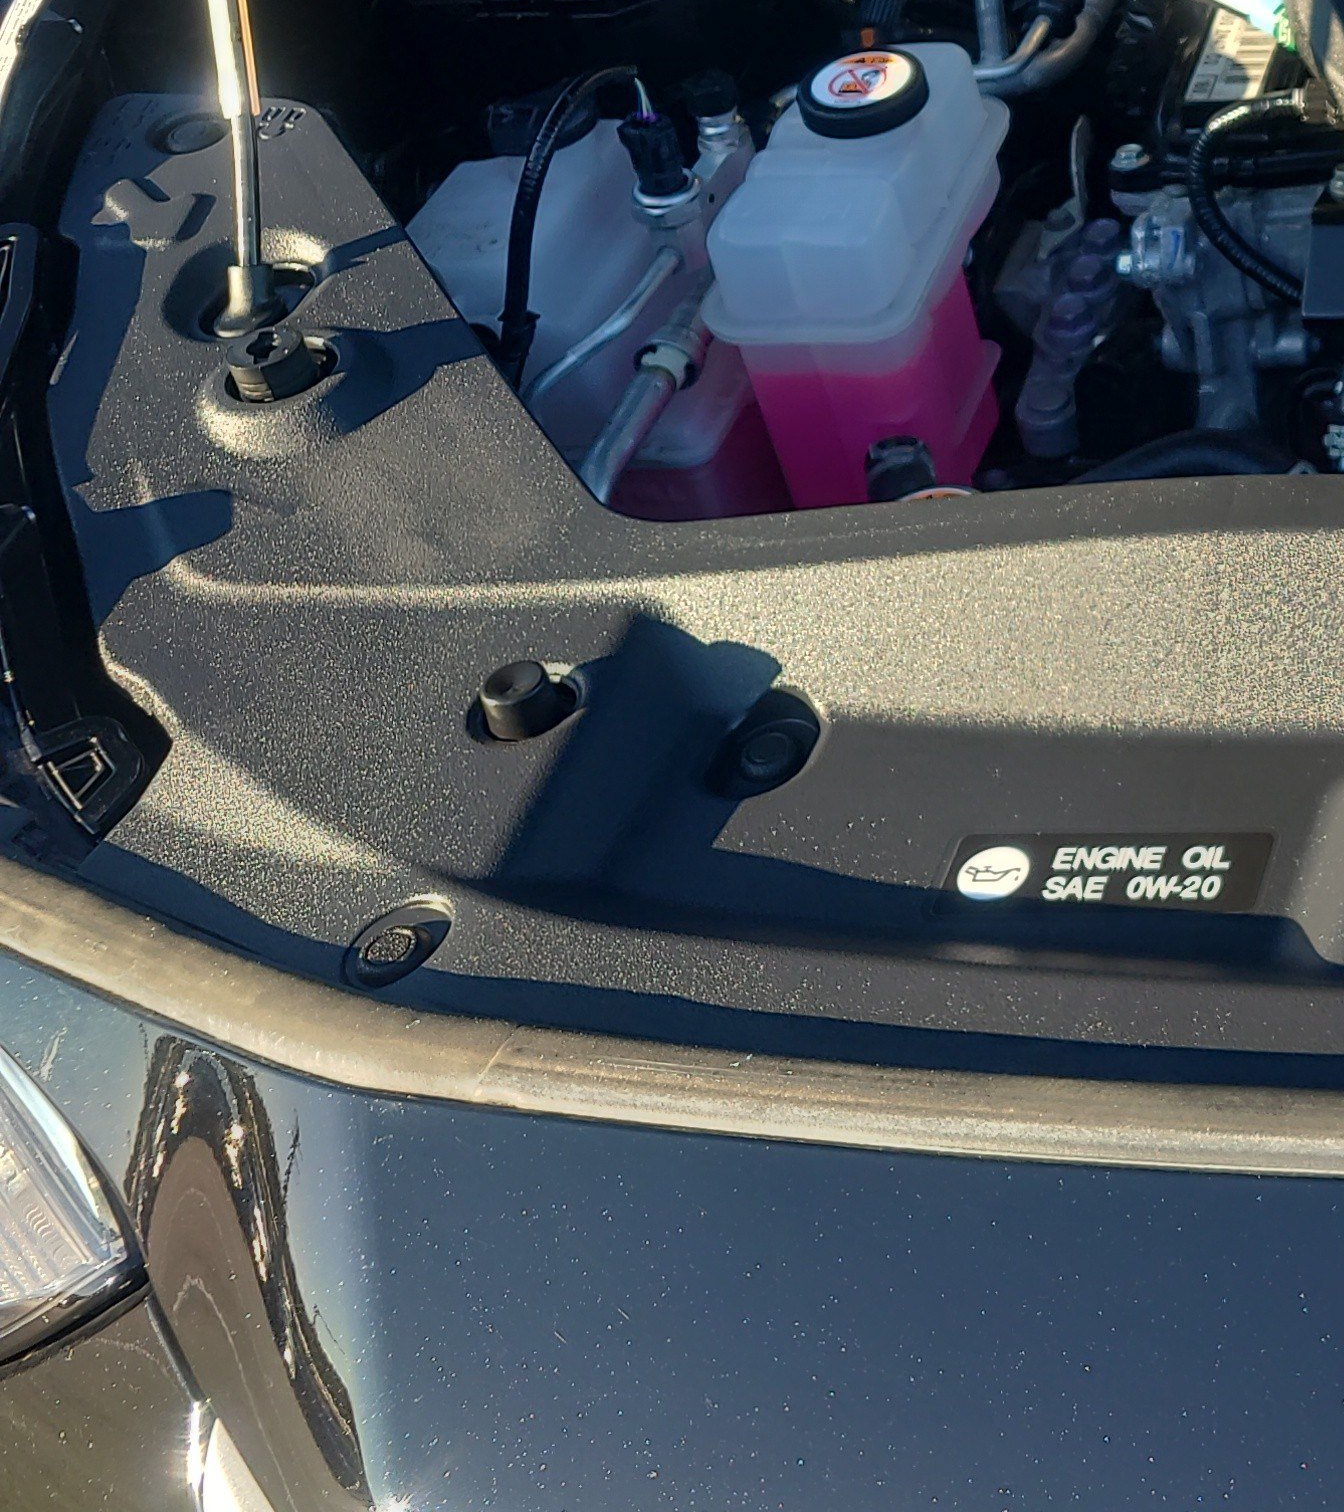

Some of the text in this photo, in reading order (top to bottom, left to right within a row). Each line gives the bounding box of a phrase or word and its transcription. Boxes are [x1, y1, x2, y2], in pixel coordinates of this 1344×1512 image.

[1051, 846, 1232, 872] ENGINE OIL
[1041, 875, 1222, 901] SAE 0W-20
